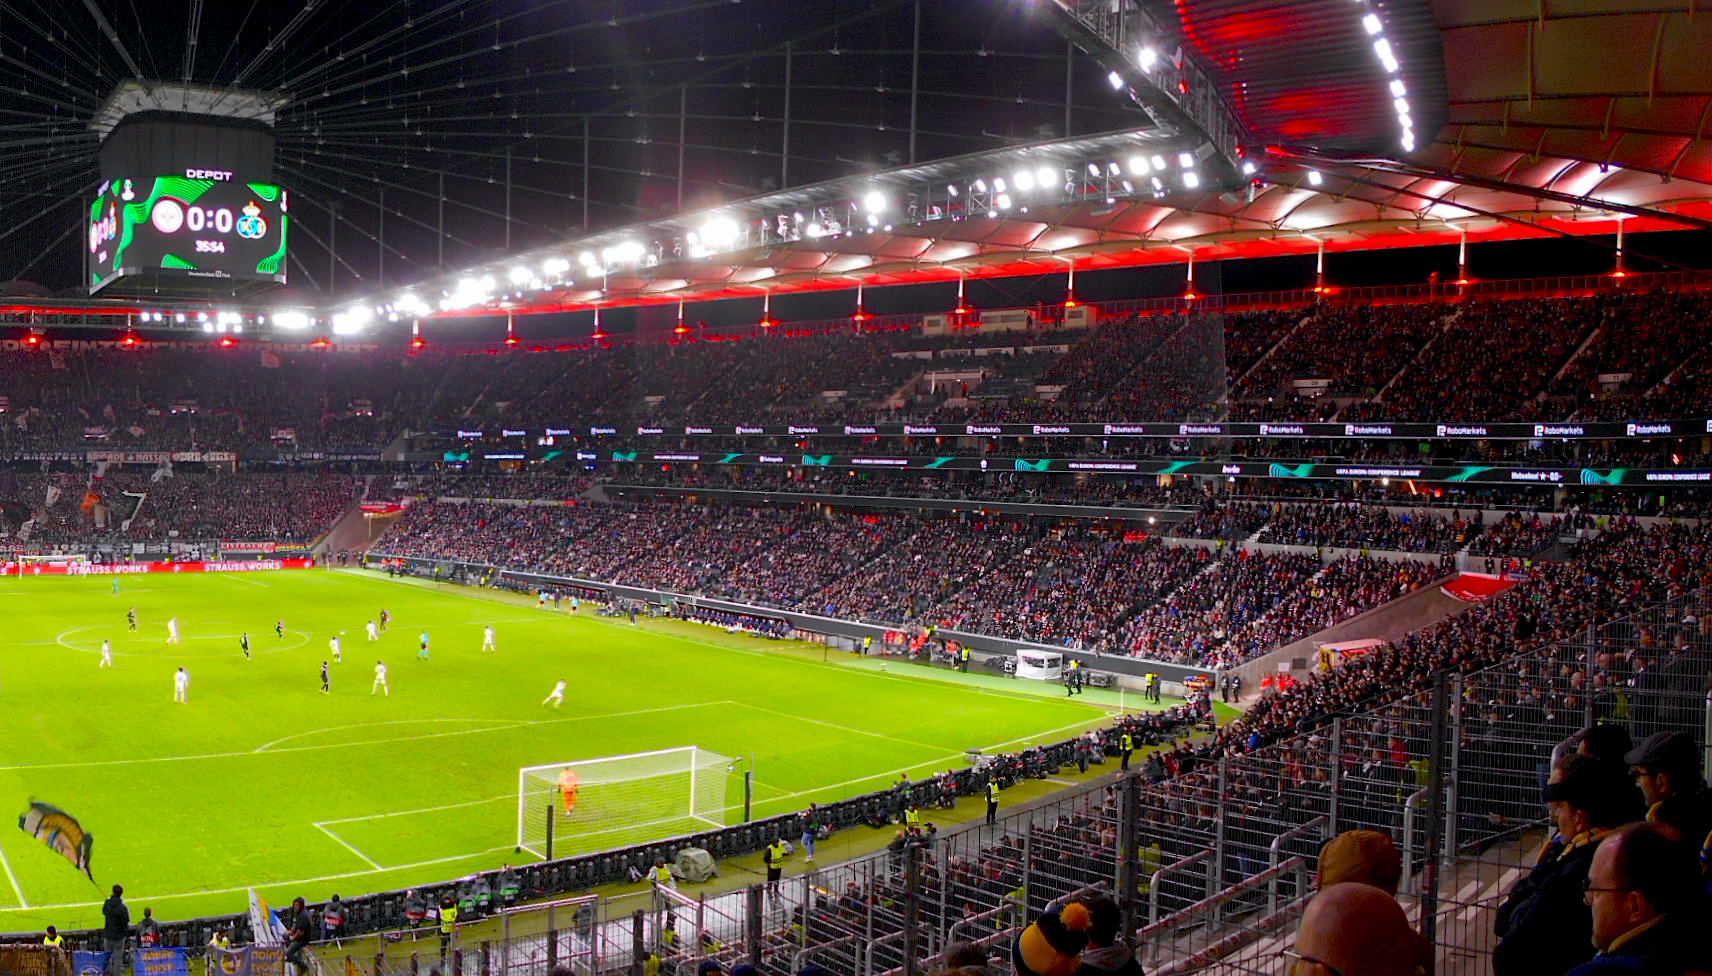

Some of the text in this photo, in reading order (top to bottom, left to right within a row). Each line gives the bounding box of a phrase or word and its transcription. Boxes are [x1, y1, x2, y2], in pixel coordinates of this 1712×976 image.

[186, 169, 232, 181] DEPOT
[187, 206, 233, 233] 0:0
[1268, 426, 1303, 435] RoboMarkets
[1354, 426, 1392, 435] RoboMarkets
[1446, 426, 1487, 435] RoboMarkets
[1544, 426, 1583, 436] RoboMarkets
[1636, 424, 1671, 434] RoboMarkets
[1222, 464, 1241, 474] bwin
[67, 565, 148, 575] STRAUSS.WORKS
[204, 562, 281, 572] STRAUSS.WORKS
